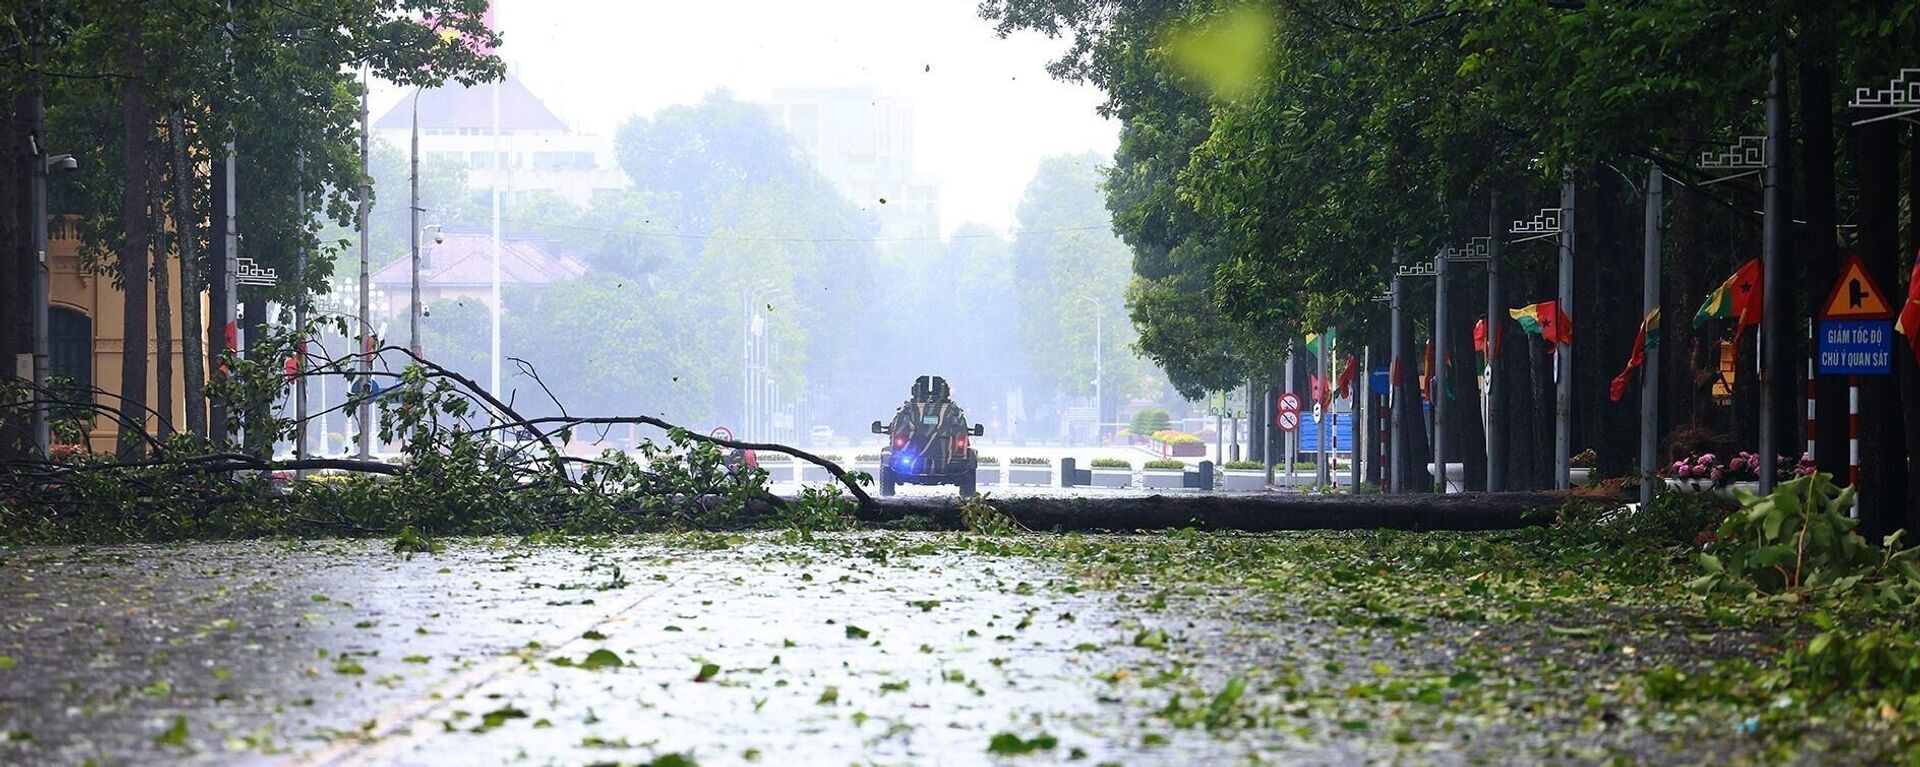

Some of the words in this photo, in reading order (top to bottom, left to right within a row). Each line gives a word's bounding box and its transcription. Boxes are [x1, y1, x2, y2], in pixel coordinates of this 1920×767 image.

[1828, 325, 1850, 344] GIẢM
[1852, 325, 1869, 344] TỐC
[1870, 326, 1882, 346] ĐỘ
[1822, 349, 1839, 366] CHÚ
[1841, 349, 1847, 366] Ý
[1847, 352, 1871, 367] QUAN
[1872, 349, 1888, 366] SÁT
